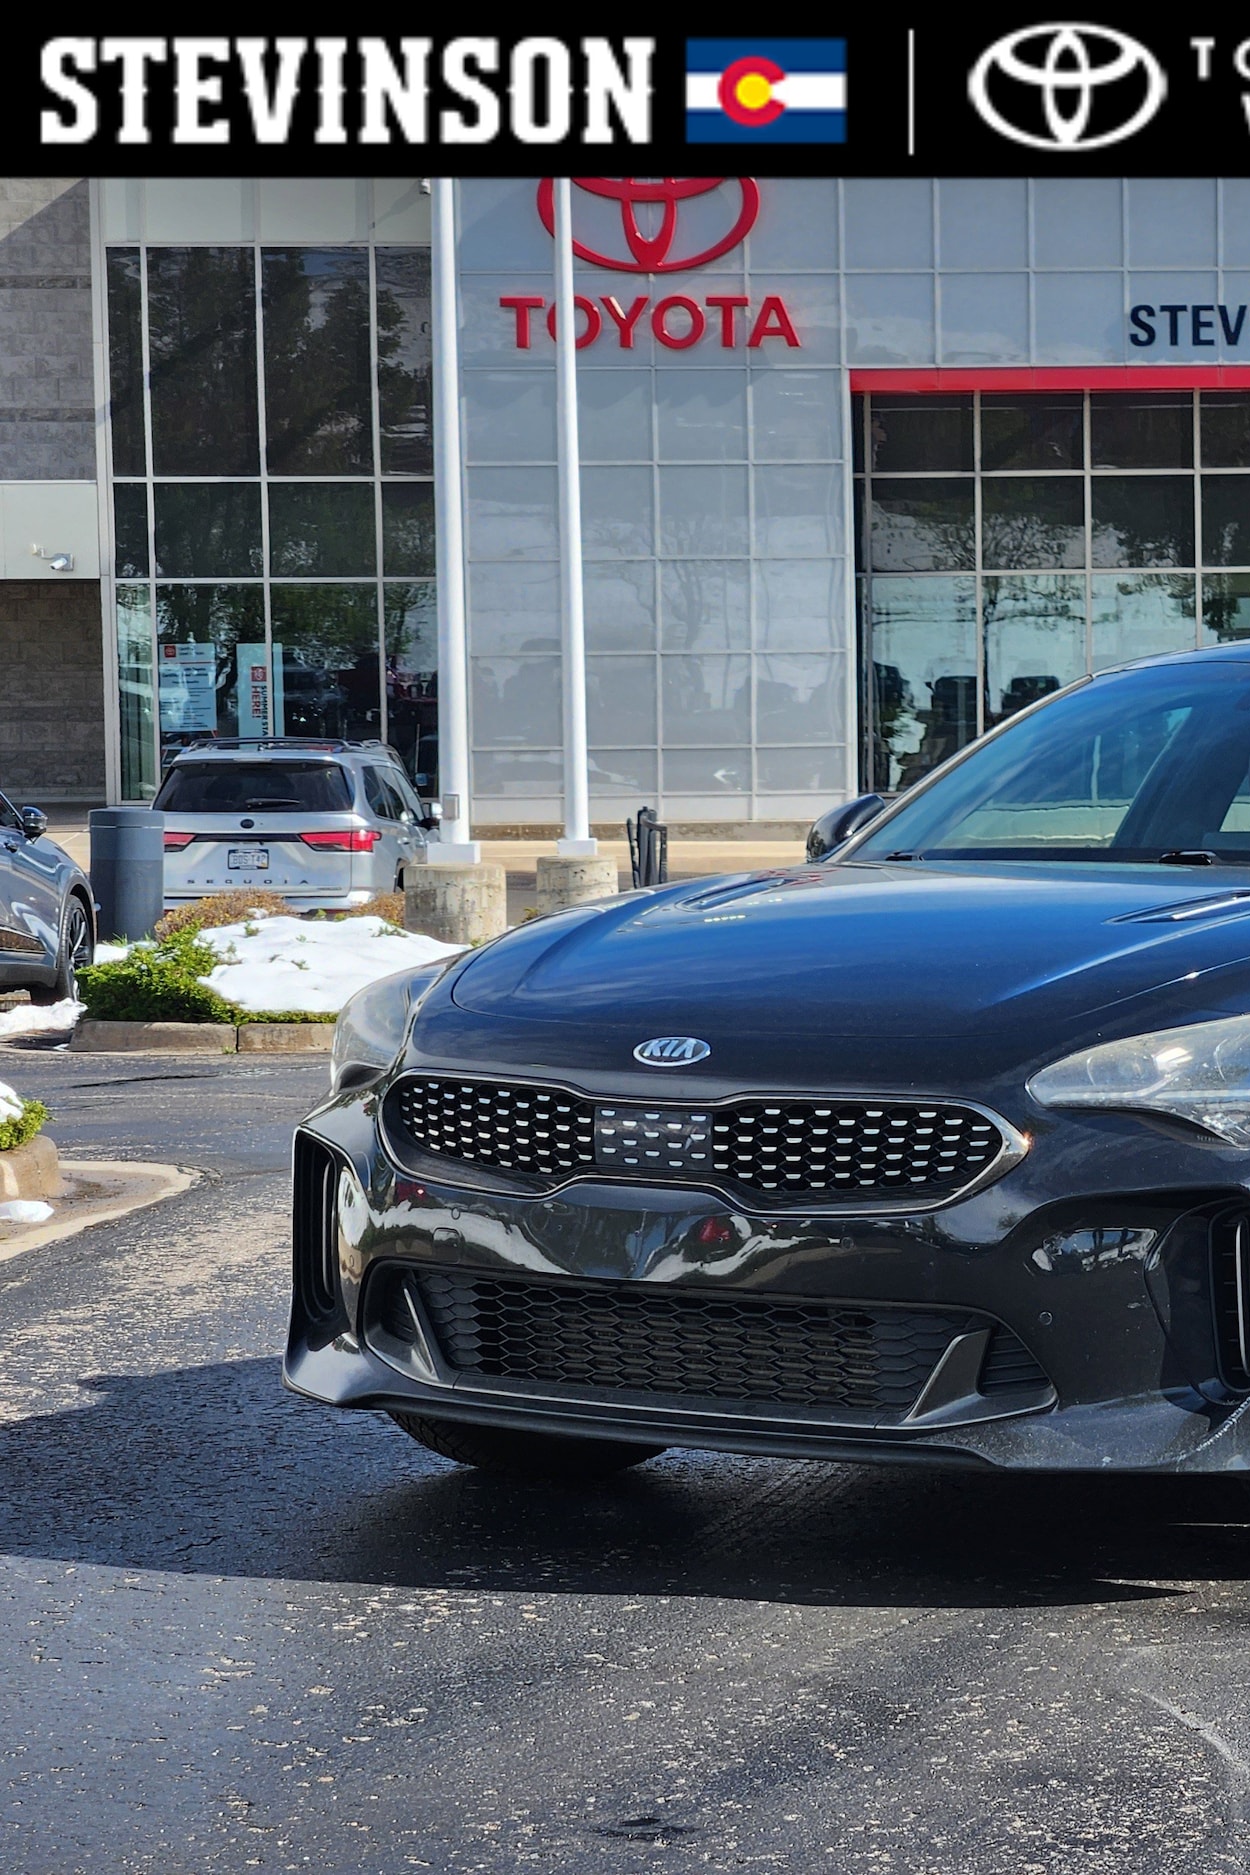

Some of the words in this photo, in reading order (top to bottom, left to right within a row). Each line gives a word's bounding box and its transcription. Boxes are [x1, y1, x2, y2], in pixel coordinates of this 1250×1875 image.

[500, 296, 801, 349] TOYOTA
[251, 685, 262, 718] HERE!
[642, 1039, 698, 1058] KIA
